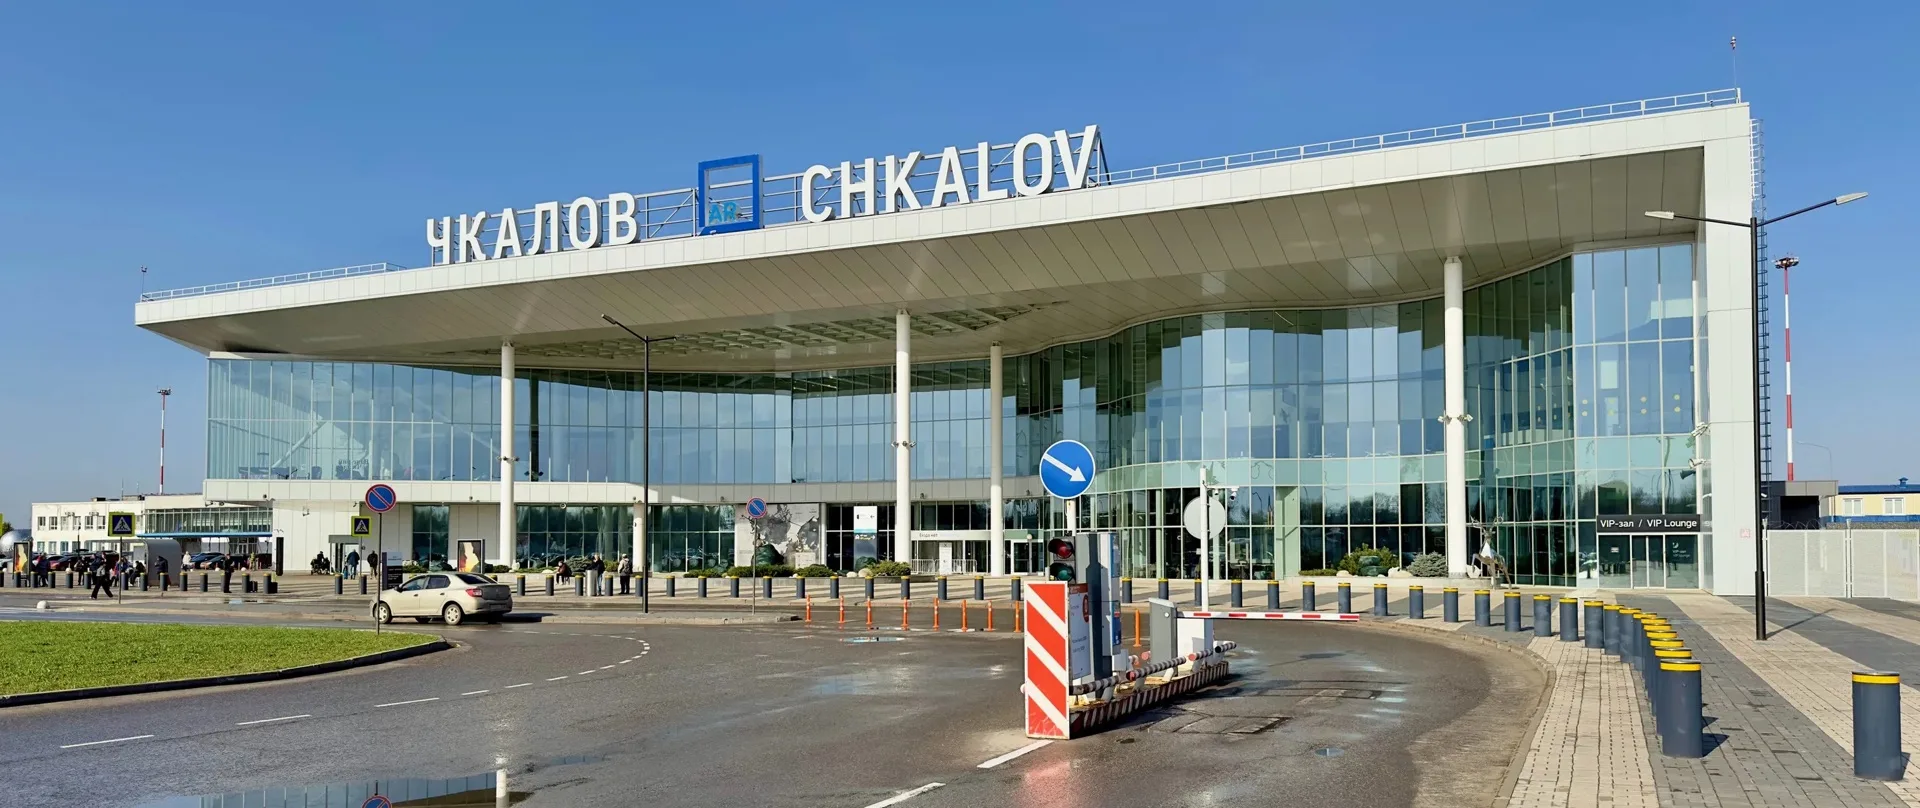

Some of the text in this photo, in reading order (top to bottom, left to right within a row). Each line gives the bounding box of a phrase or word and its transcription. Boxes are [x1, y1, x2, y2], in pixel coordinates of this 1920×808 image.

[800, 124, 1099, 223] CHKALOV
[426, 191, 639, 265] ЧКАЛОВ
[1600, 519, 1634, 527] VIP-зал
[1647, 519, 1662, 528] VIP
[1664, 519, 1697, 528] Lounge
